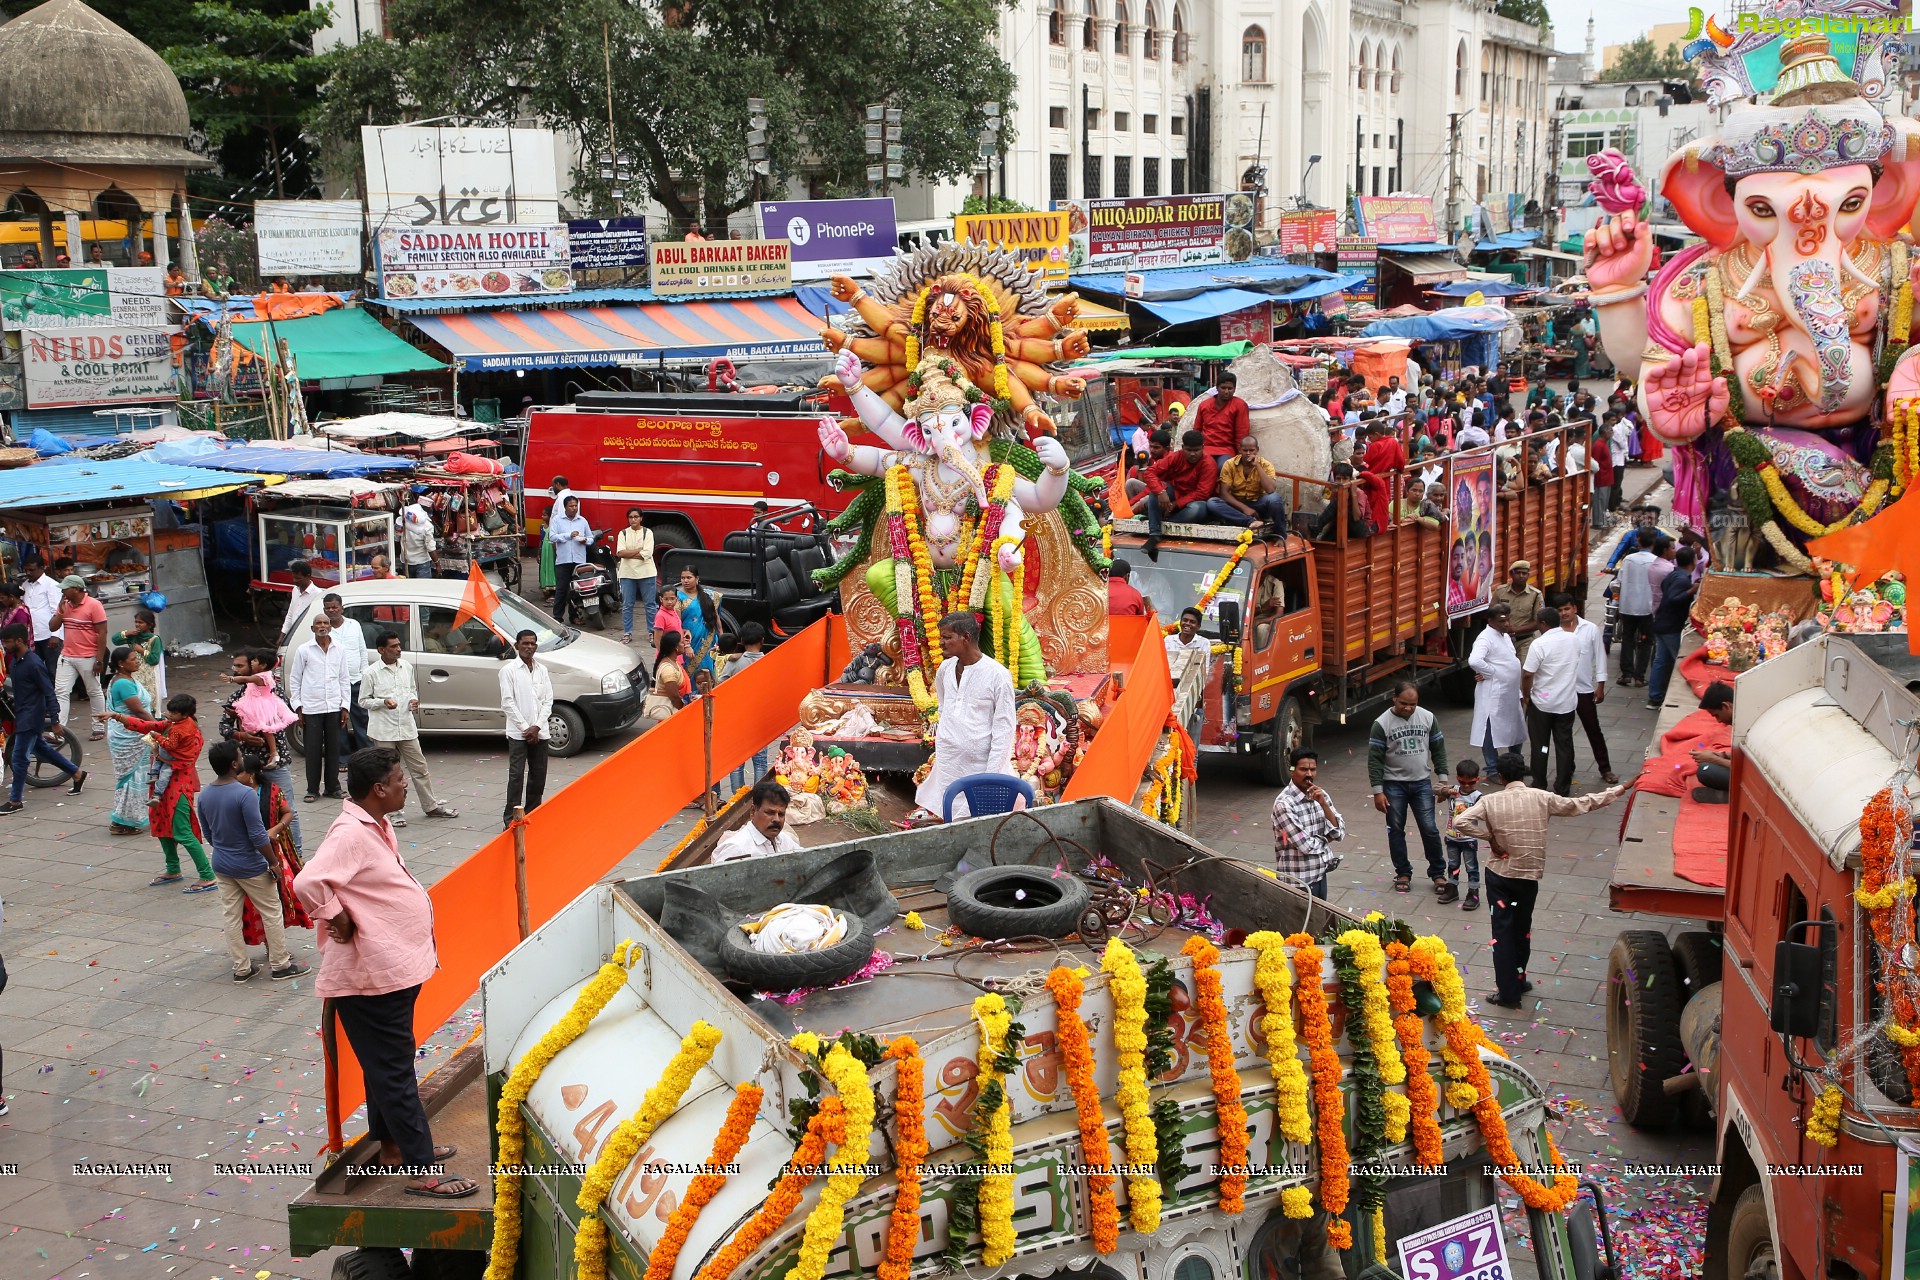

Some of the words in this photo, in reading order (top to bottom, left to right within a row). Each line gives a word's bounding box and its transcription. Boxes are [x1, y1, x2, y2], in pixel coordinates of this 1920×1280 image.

[410, 137, 436, 158] اخبار
[411, 183, 514, 226] اعتماد
[1092, 205, 1174, 229] MUQADDAR
[1178, 203, 1222, 222] HOTEL
[285, 229, 307, 238] MEDICAL
[308, 229, 329, 238] OFFICERS
[329, 227, 359, 237] ASSOCIATION
[816, 222, 875, 239] PhonePe
[967, 217, 1061, 245] MUNNU
[1092, 231, 1124, 242] KALYANI
[1126, 229, 1157, 241] BIRYANI,
[1158, 228, 1190, 238] CHICKEN
[1194, 225, 1222, 236] BIRYANI
[400, 232, 483, 251] SADDAM
[489, 231, 550, 250] HOTEL
[1102, 244, 1115, 252] SPL.
[1117, 242, 1140, 251] TAHARI,
[1142, 241, 1166, 250] BAGARA
[1189, 237, 1212, 246] DALCHA
[408, 252, 438, 263] FAMILY
[441, 251, 476, 262] SECTION
[479, 250, 499, 260] ALSO
[502, 249, 546, 260] AVAILABLE
[656, 248, 687, 264] ABUL
[691, 246, 743, 263] BARKAAT
[747, 245, 788, 260] BAKERY
[1160, 251, 1177, 263] होटल
[704, 265, 735, 273] DRINKS
[760, 263, 786, 271] CREAM
[72, 282, 102, 298] Sprite
[122, 297, 150, 305] NEEDS
[1100, 320, 1118, 328] DRINKS
[126, 334, 169, 345] GENERA
[30, 335, 124, 362] NEEDS
[726, 347, 748, 357] ABUL
[751, 345, 791, 354] BARKAAT
[793, 343, 824, 352] BAKERY
[483, 356, 510, 367] SADDAM
[512, 356, 533, 366] HOTEL
[535, 355, 559, 364] FAMILY
[561, 354, 588, 363] SECTION
[590, 353, 607, 362] ALSO
[609, 353, 643, 362] AVAILABLE
[62, 365, 68, 376] &
[75, 363, 109, 376] COOL
[113, 361, 149, 374] POINT
[637, 418, 692, 430] తెలంగాణ
[695, 420, 722, 437] రాష్ట్ర
[603, 436, 625, 449] విపత్తు
[626, 437, 651, 450] స్పందన
[653, 437, 681, 448] మరియు
[683, 438, 718, 451] అగ్నిమాపక
[720, 438, 739, 450] సేవల
[741, 440, 758, 451] శాఖ
[1403, 738, 1417, 750] 19
[1410, 1250, 1439, 1280] S
[1468, 1226, 1498, 1268] Z
